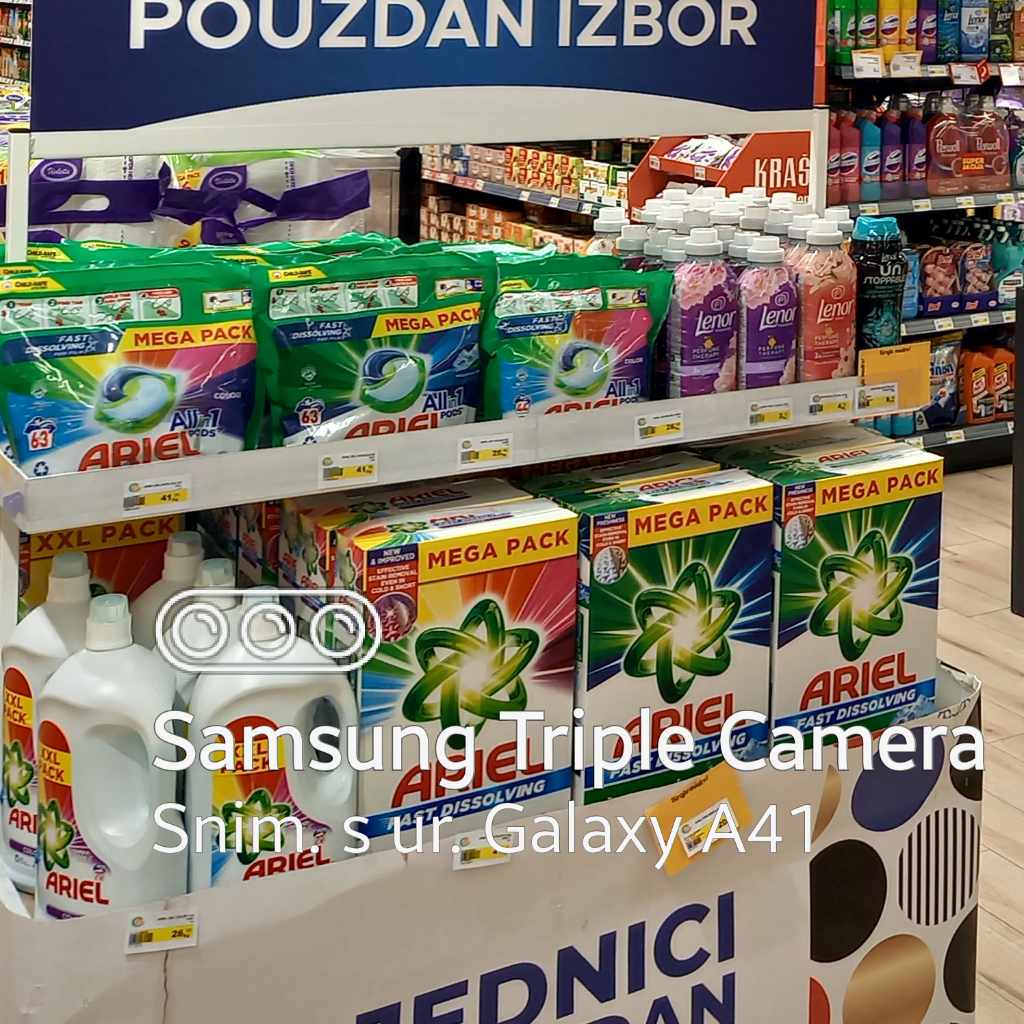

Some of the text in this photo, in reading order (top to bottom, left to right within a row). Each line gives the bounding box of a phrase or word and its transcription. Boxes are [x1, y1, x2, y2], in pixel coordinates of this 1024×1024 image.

[754, 153, 810, 188] KRAŠ
[385, 309, 482, 332] MEGA PACK
[695, 310, 737, 337] Lenor
[759, 305, 798, 332] Lenor
[816, 299, 855, 324] Lenor
[58, 334, 89, 343] FAST
[134, 325, 253, 347] MEGA PACK
[291, 329, 342, 339] DISSOLVING
[301, 410, 319, 424] 63
[31, 431, 49, 448] 63
[79, 431, 200, 472] ARIEL
[822, 469, 939, 505] MEGA PACK
[634, 508, 701, 536] MEGA
[708, 495, 768, 522] PACK
[37, 516, 176, 552] XXL PACK
[428, 542, 497, 570] MEGA
[507, 528, 570, 555] PACK
[377, 553, 415, 564] IMPROVED
[383, 548, 401, 556] NEW
[799, 651, 918, 712] ARIEL
[796, 689, 916, 729] FAST DISSOLVING
[391, 738, 546, 809] ARIEL
[440, 779, 546, 819] DISSOLVING
[8, 807, 37, 834] ARI
[243, 844, 332, 881] ARIEL
[45, 870, 111, 906] ARIEL
